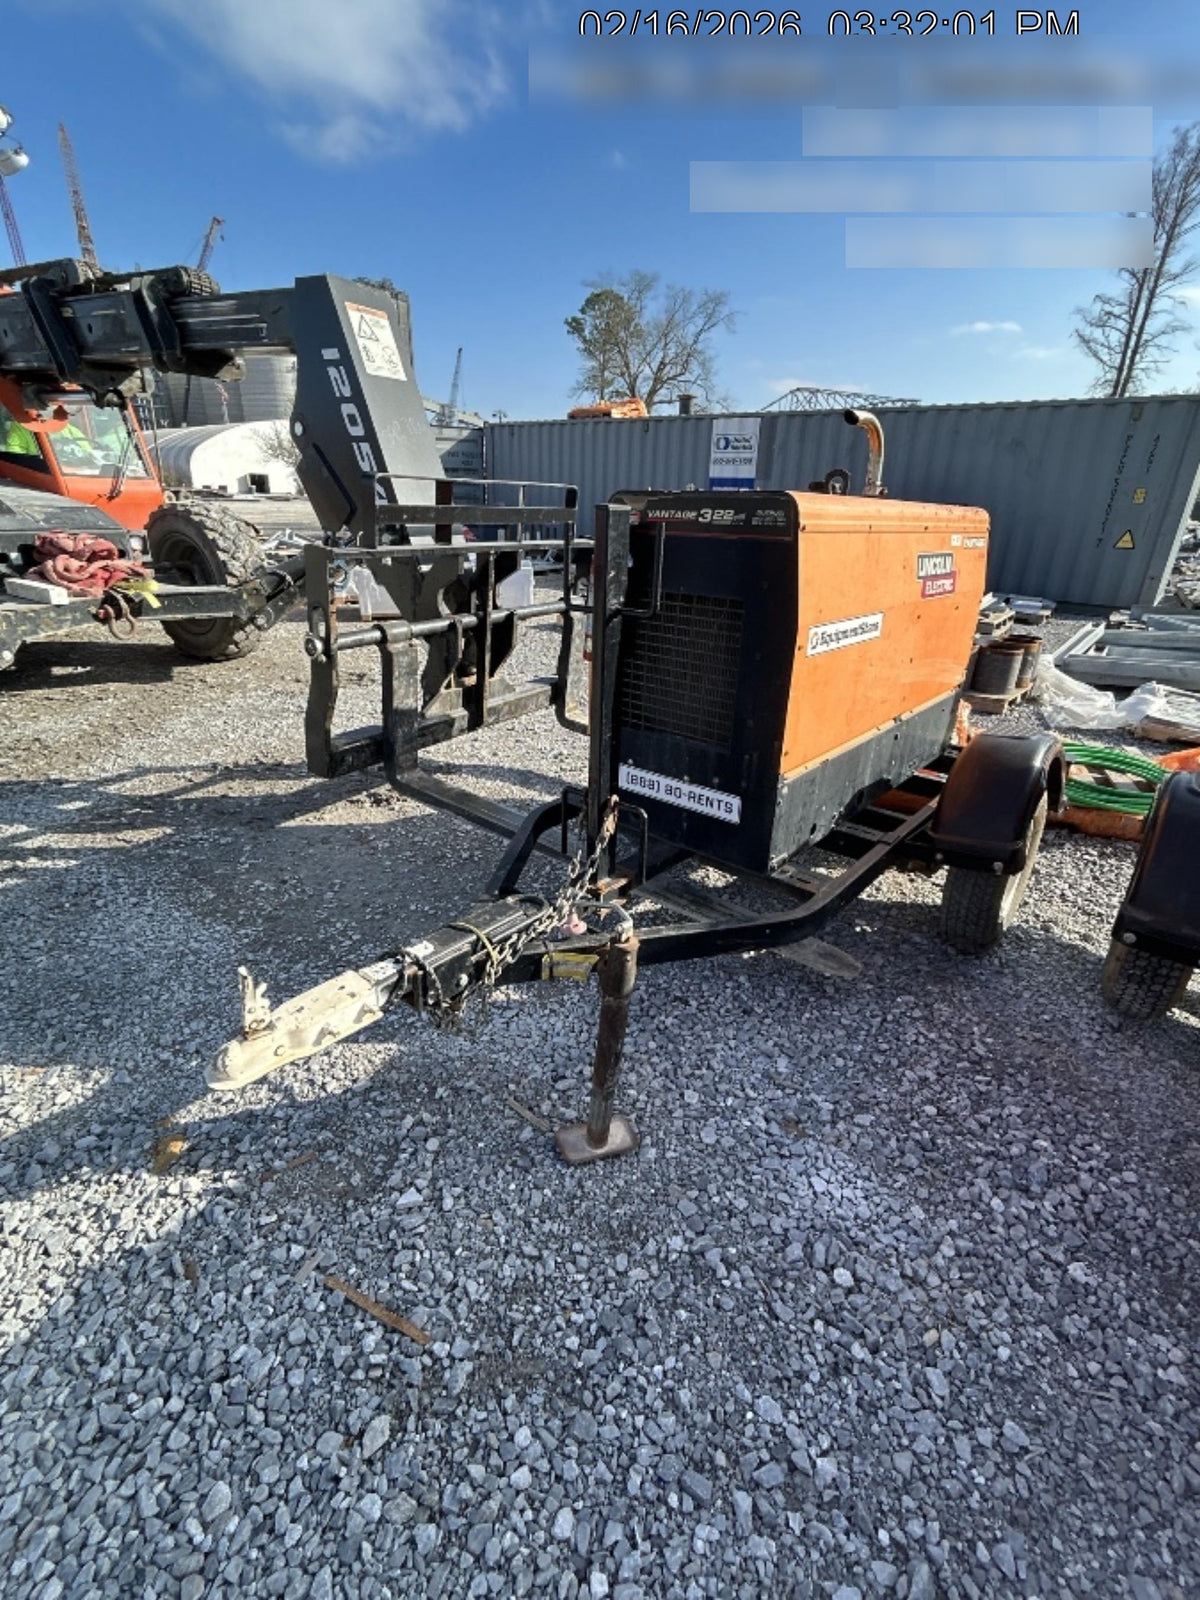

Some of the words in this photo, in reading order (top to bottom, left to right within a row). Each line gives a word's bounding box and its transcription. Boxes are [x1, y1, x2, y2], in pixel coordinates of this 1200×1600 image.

[647, 509, 697, 520] VANTAGE
[698, 507, 735, 523] 322
[918, 555, 953, 577] LINCOLN
